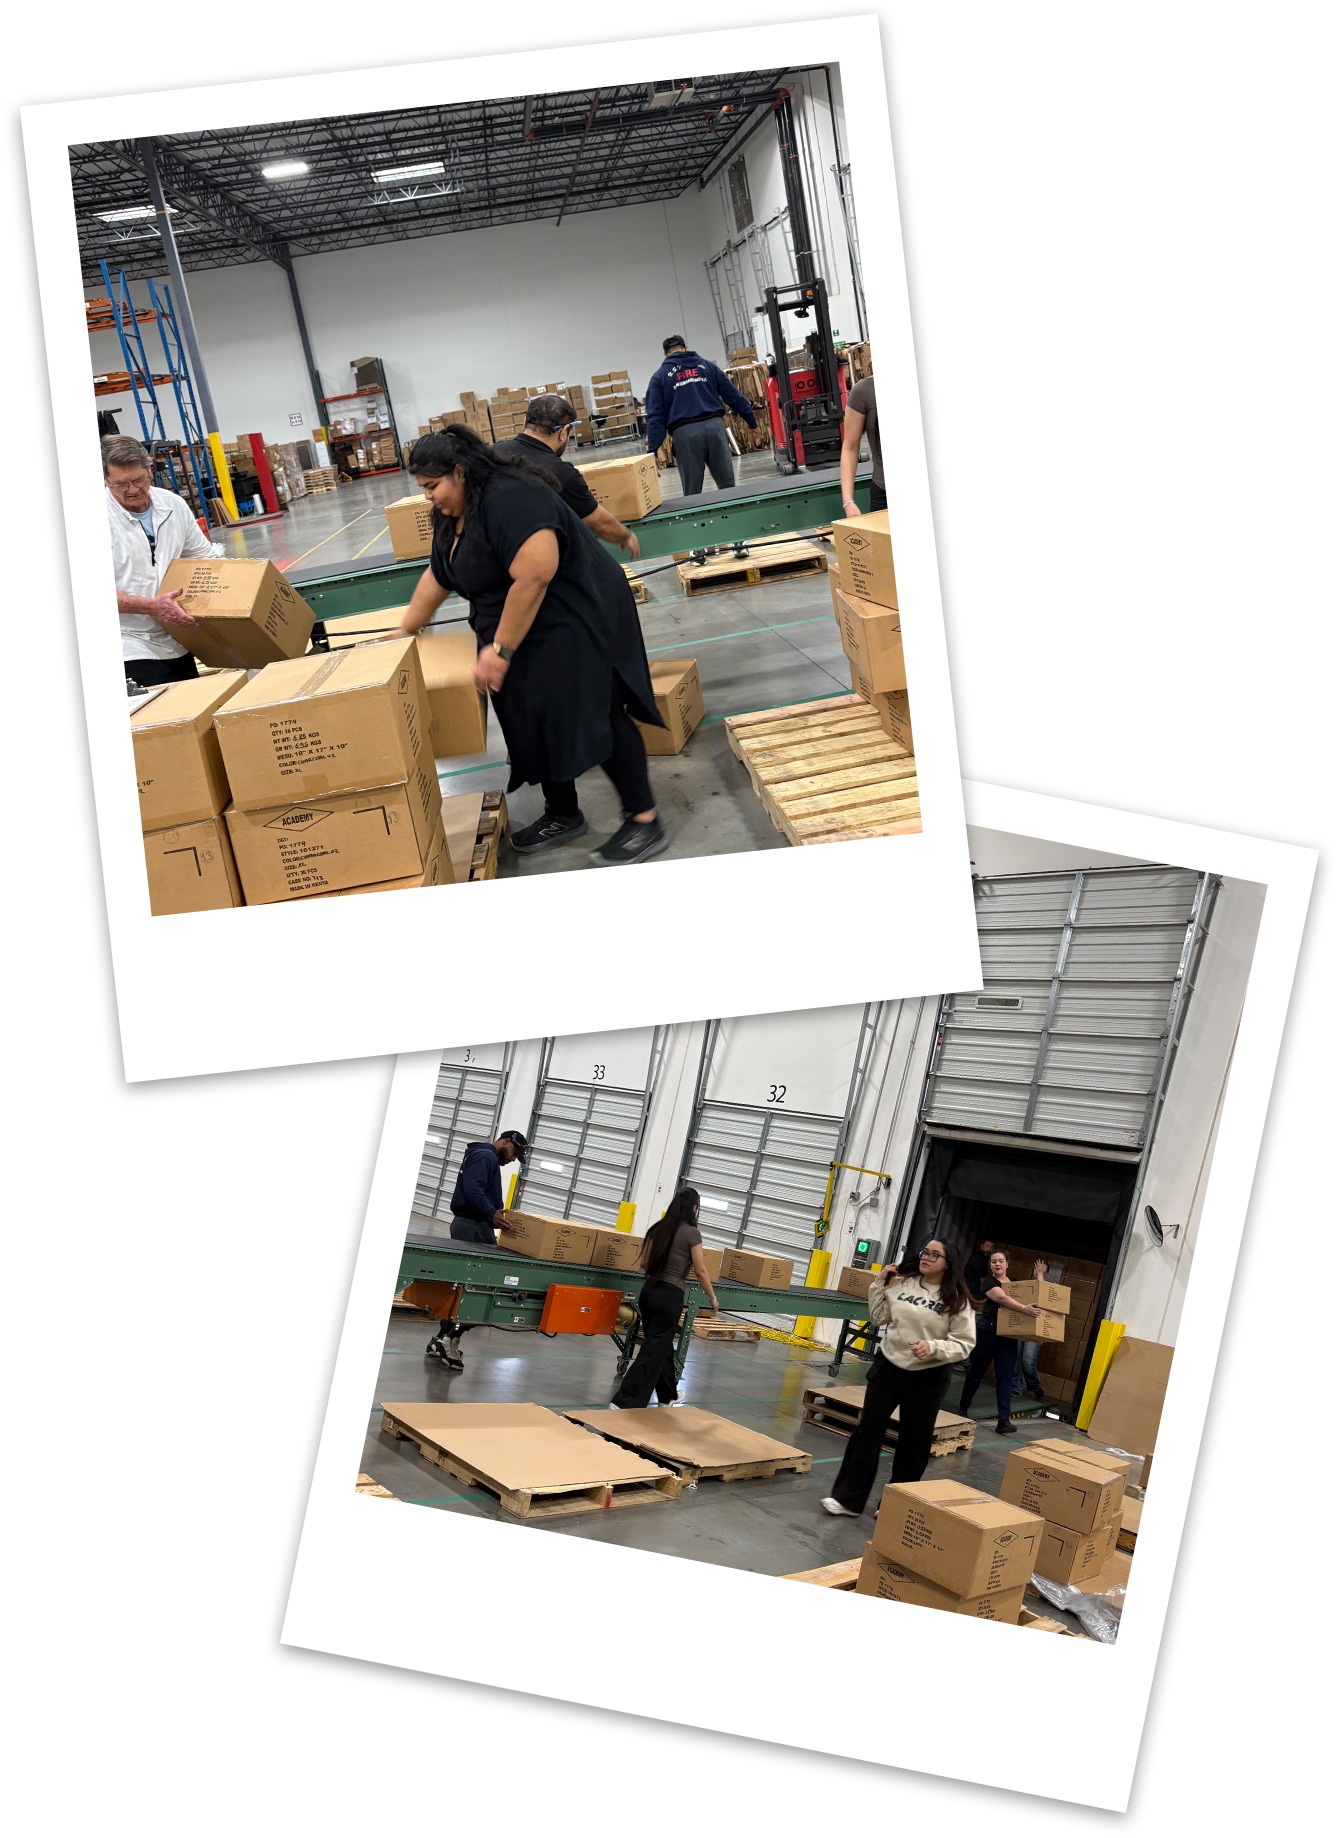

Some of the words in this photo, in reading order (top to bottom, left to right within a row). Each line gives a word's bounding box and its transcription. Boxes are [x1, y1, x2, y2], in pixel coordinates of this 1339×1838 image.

[677, 368, 698, 380] FIRE
[282, 812, 314, 826] ACADEMY
[592, 1064, 606, 1080] 33
[767, 1085, 786, 1103] 32
